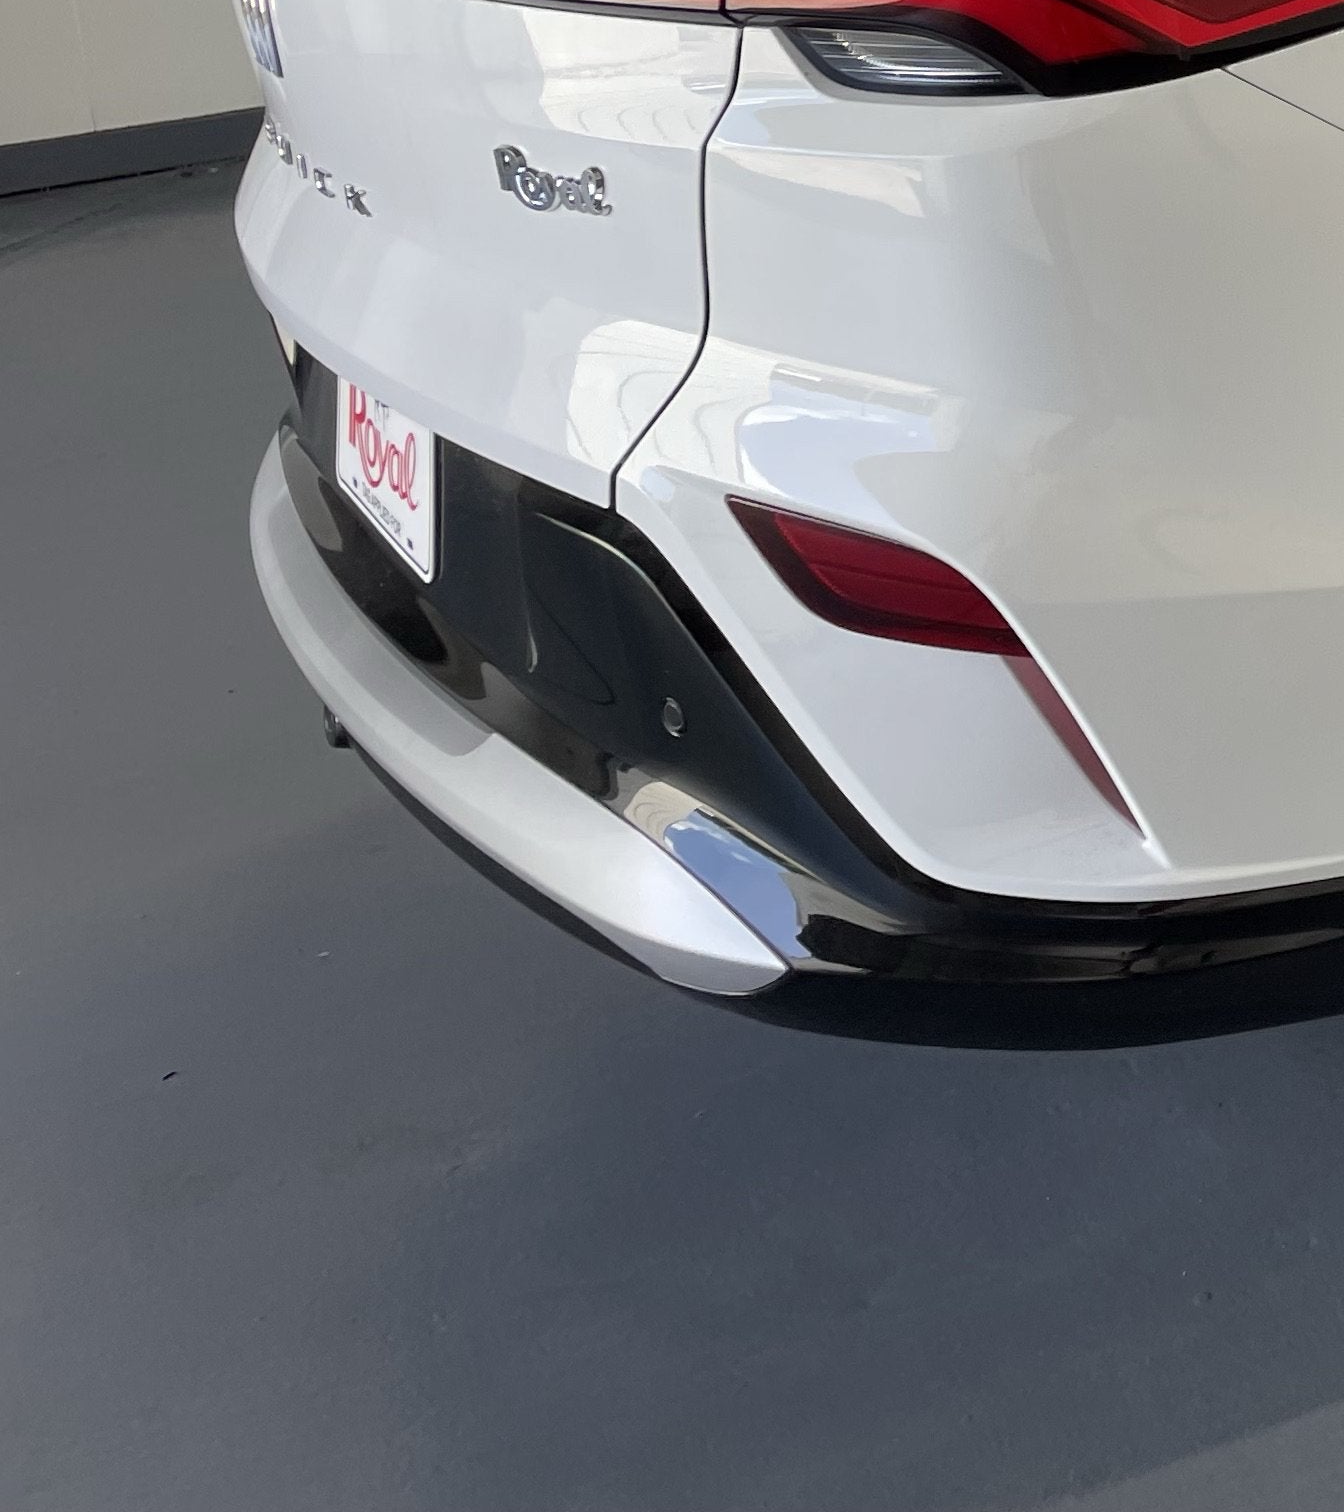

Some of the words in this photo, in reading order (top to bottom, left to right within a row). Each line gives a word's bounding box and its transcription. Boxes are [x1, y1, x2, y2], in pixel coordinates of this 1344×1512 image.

[264, 115, 373, 218] BUICK
[493, 145, 612, 216] Royal
[349, 384, 418, 510] Royal
